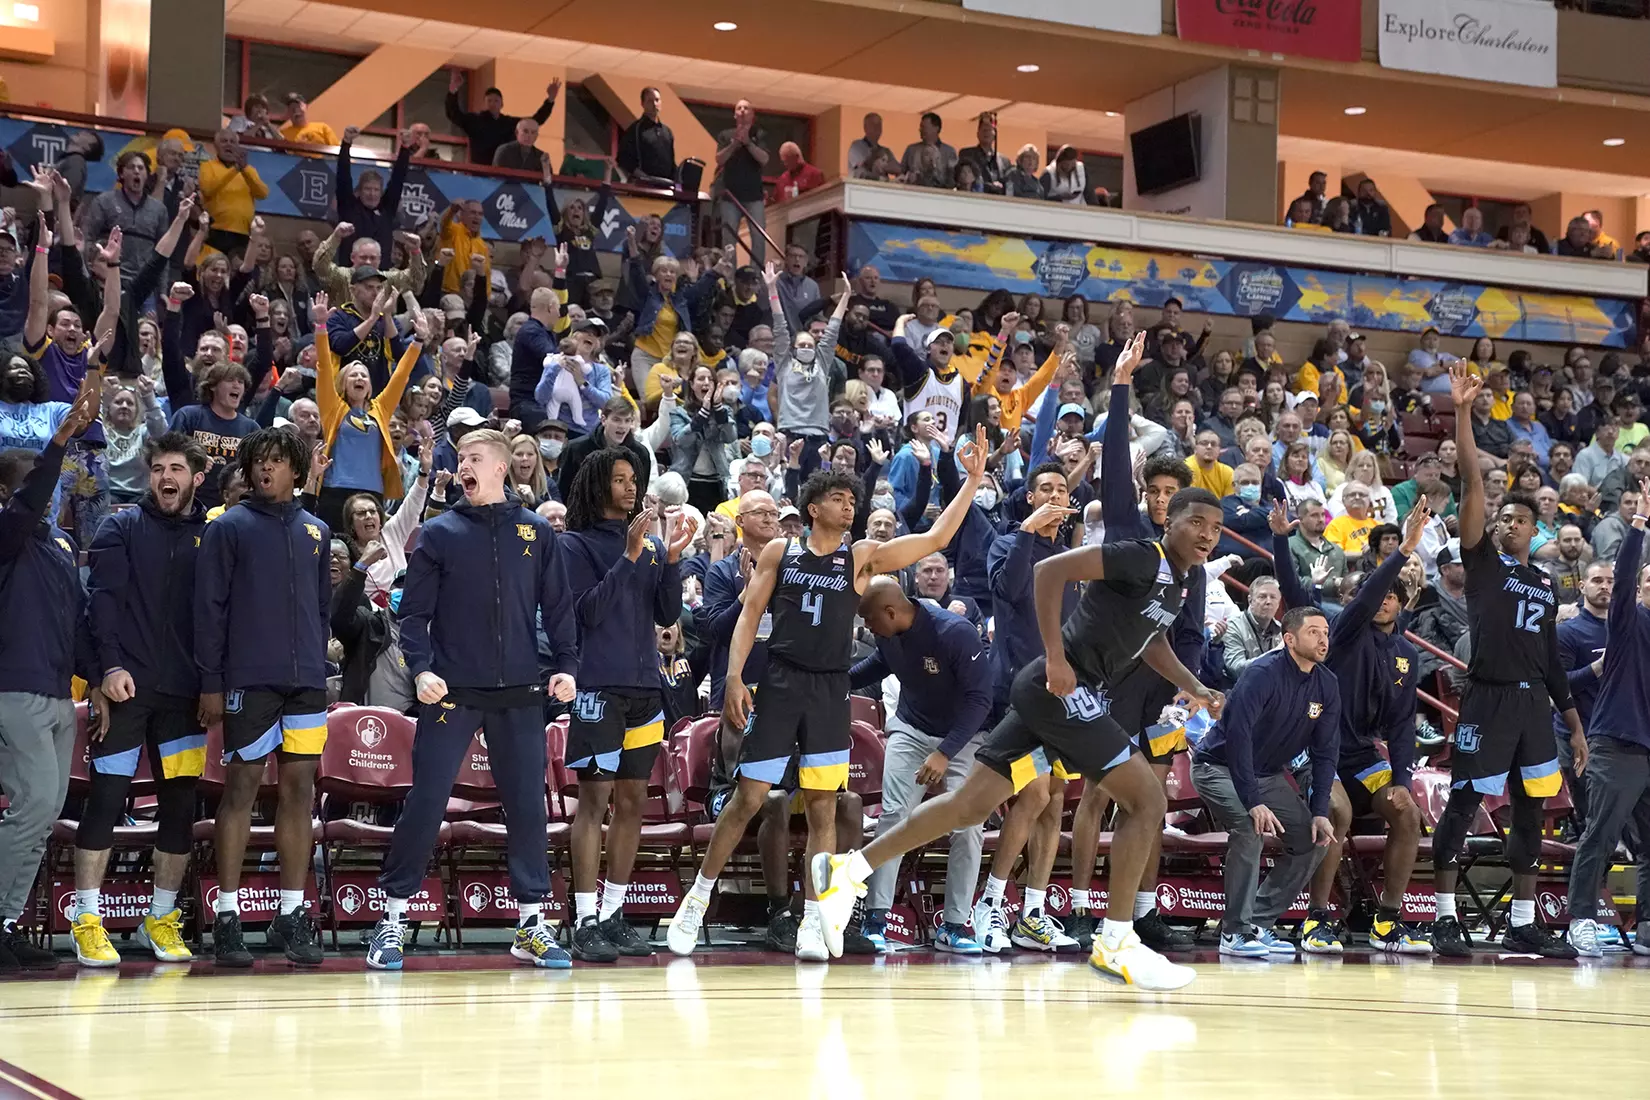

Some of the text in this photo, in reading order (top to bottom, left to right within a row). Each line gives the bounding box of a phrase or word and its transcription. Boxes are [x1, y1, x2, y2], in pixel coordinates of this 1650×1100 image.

[300, 170, 328, 205] E
[496, 194, 515, 210] Ole
[499, 210, 528, 228] Miss
[194, 430, 221, 448] KENT
[221, 436, 243, 450] STA
[516, 524, 537, 541] MU
[783, 567, 848, 592] Marquette
[801, 592, 823, 627] 4
[1515, 600, 1545, 634] 12
[572, 689, 607, 722] MU
[1057, 684, 1104, 722] MU
[1455, 723, 1483, 754] MU
[351, 750, 392, 761] Shriners
[349, 758, 395, 770] Children's
[239, 887, 280, 899] Shrin
[627, 881, 667, 892] riners
[98, 893, 154, 905] Shriner
[623, 893, 675, 904] hildren's
[1402, 893, 1437, 902] Shrine
[98, 906, 150, 918] Childre
